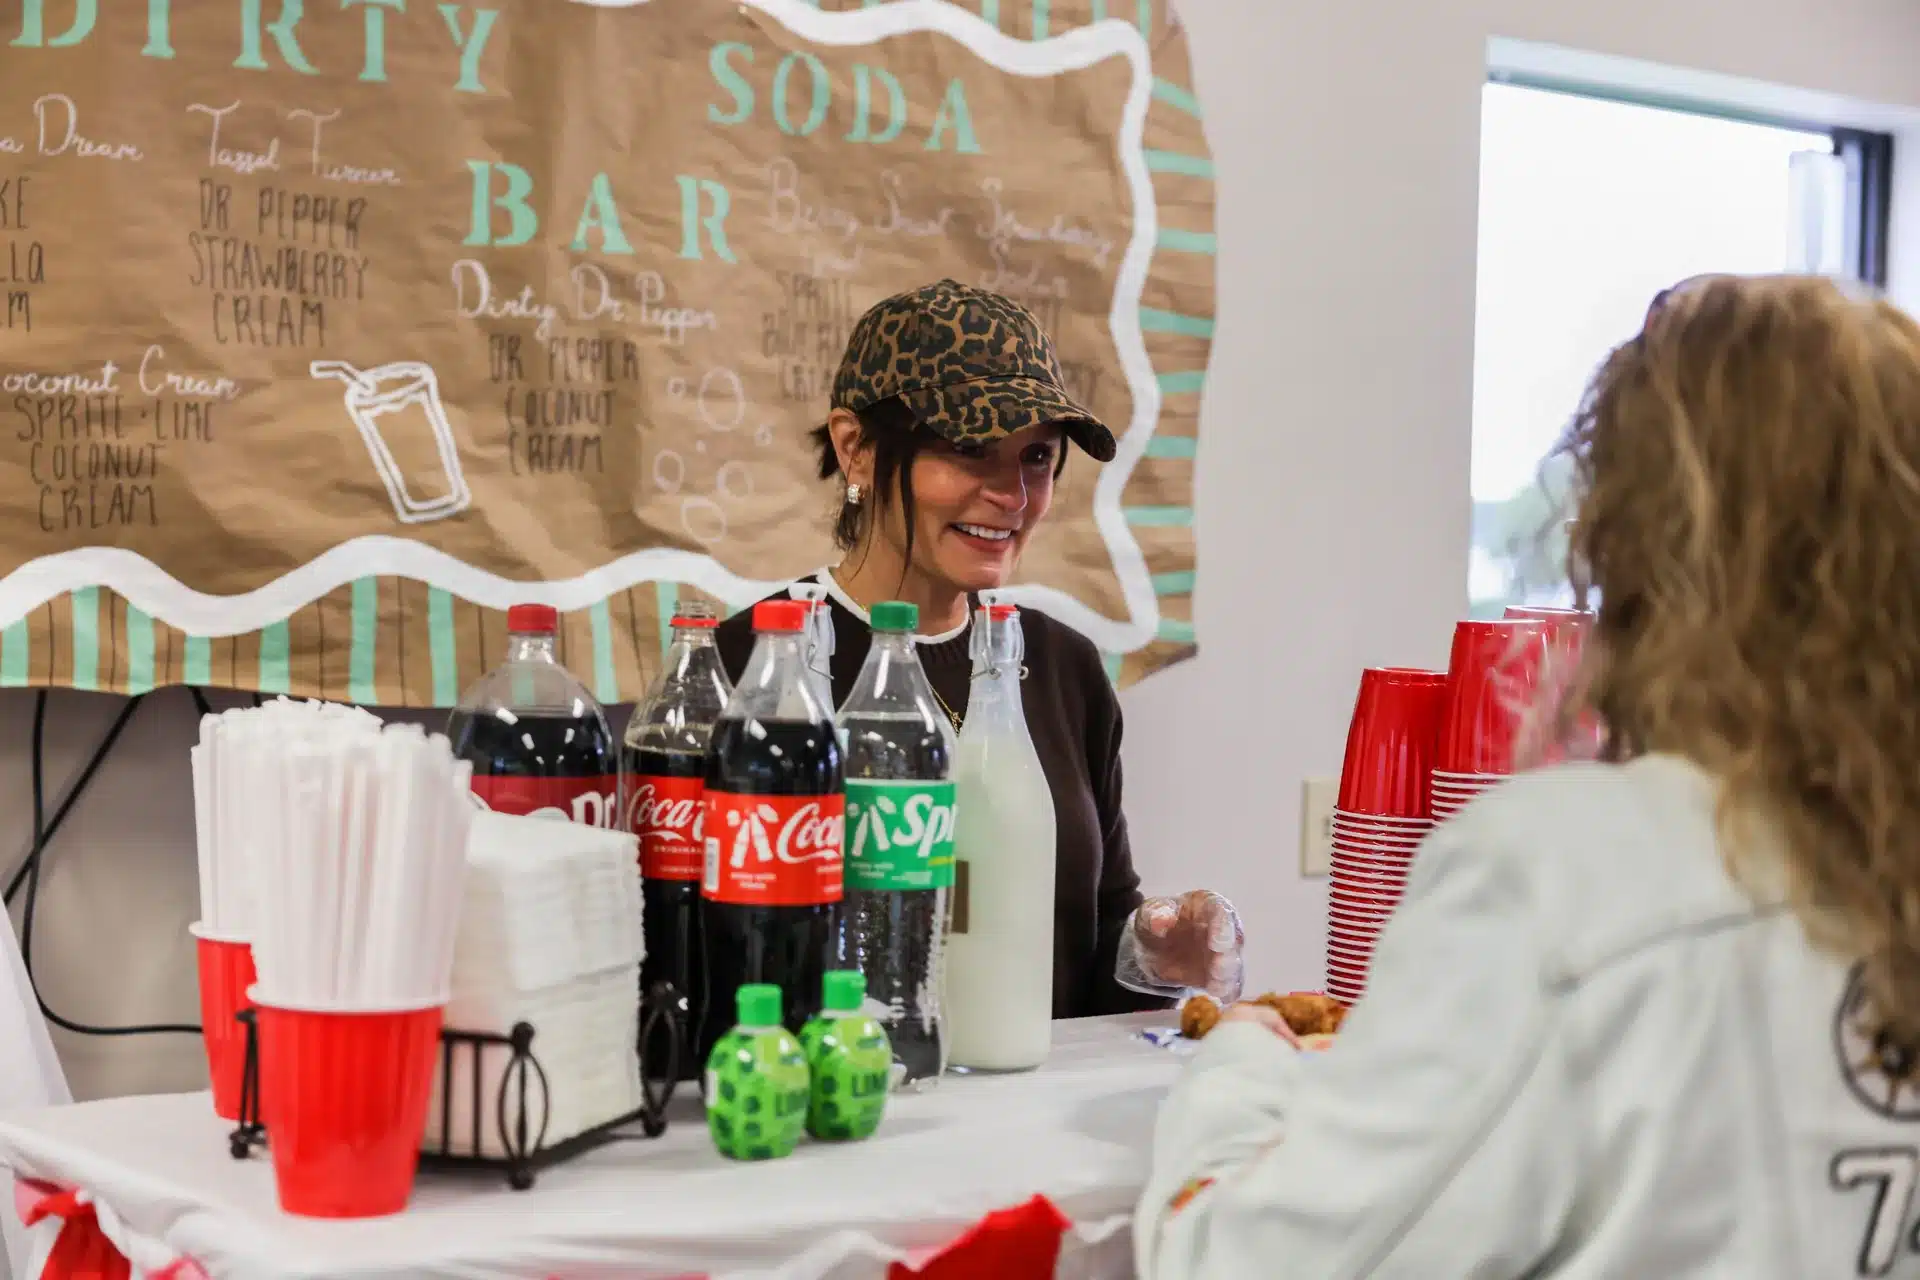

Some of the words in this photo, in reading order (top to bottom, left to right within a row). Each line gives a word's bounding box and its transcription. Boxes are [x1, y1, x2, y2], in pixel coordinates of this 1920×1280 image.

[8, 0, 499, 93] DIRTY
[33, 93, 144, 161] Dream
[707, 40, 983, 155] SODA
[200, 178, 232, 231] DR
[258, 186, 368, 249] PEPPER
[462, 159, 737, 264] BAR
[188, 231, 369, 301] STRAWBERRY
[212, 292, 325, 348] CREAM
[451, 259, 557, 342] Dirty
[634, 268, 717, 345] Pepper
[139, 344, 241, 400] Cream
[489, 333, 525, 383] DR
[548, 336, 640, 384] PEPPER
[504, 385, 618, 428] COCONUT
[30, 442, 166, 485] COCONUT
[507, 432, 605, 476] CREAM
[38, 482, 158, 532] CREAM
[1829, 1146, 1920, 1279] 7
